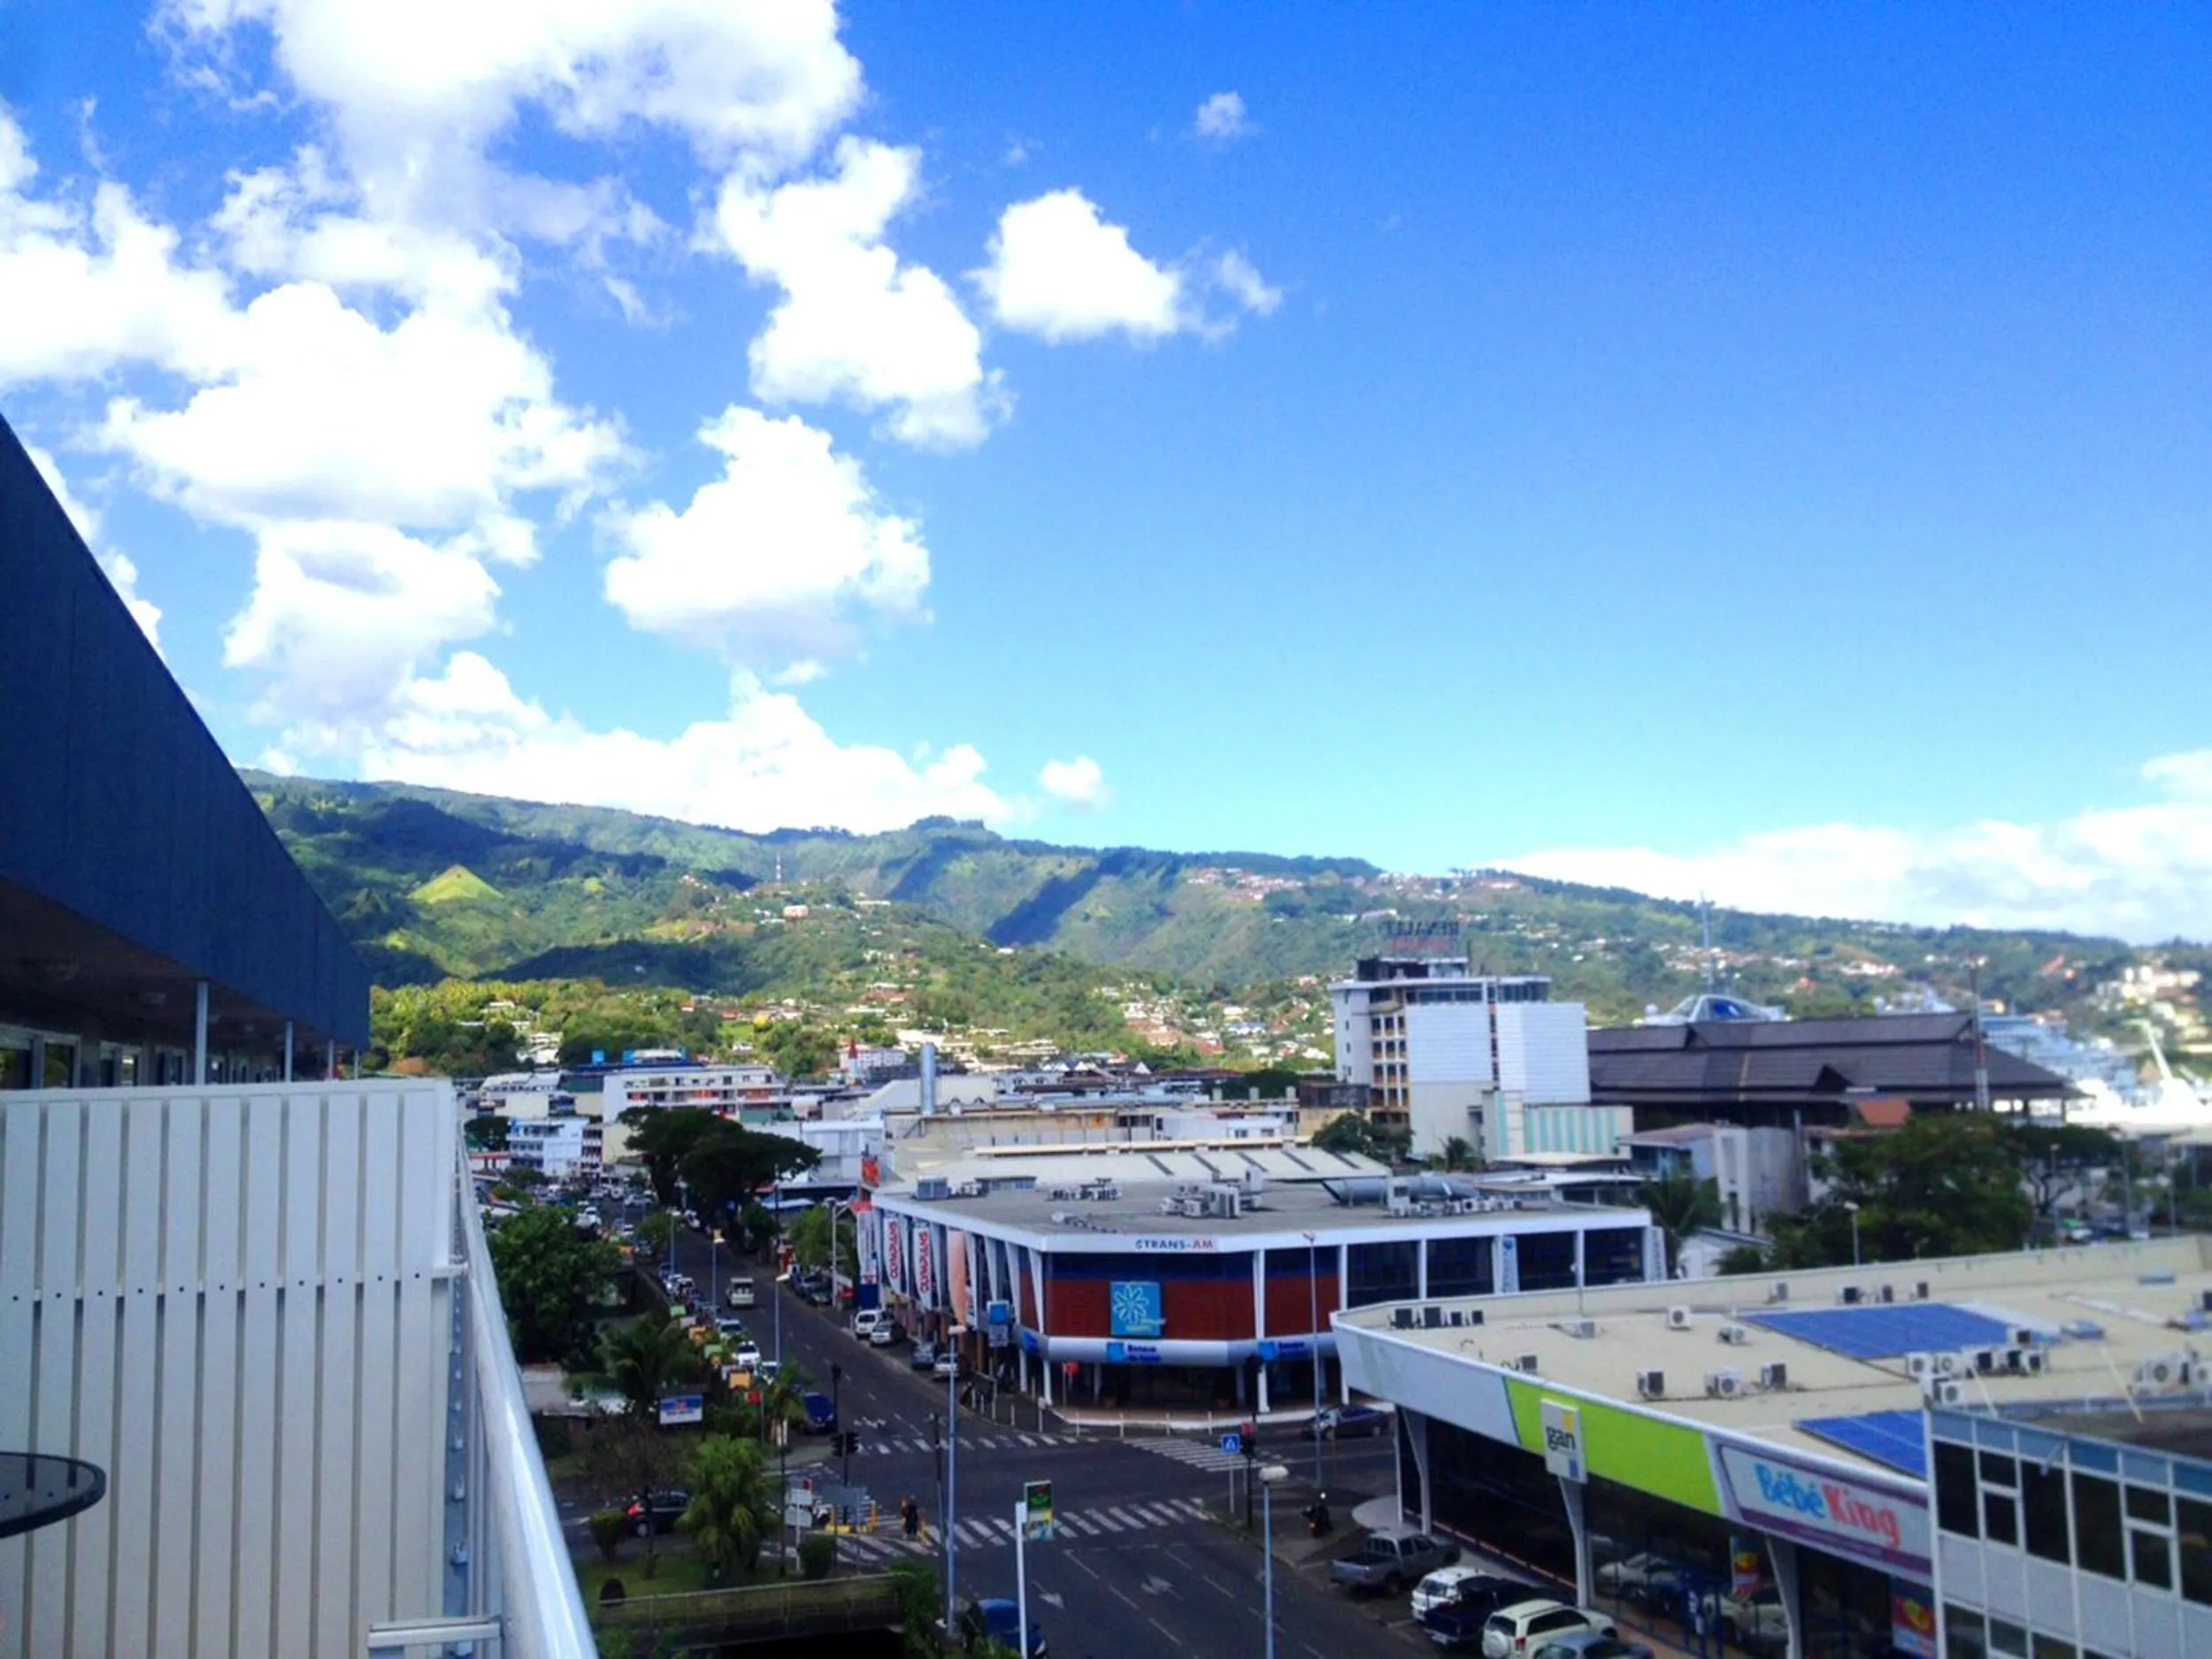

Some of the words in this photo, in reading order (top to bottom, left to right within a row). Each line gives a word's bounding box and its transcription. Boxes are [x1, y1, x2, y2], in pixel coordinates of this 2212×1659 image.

[1546, 1426, 1576, 1451] gan
[1755, 1463, 1825, 1519] Bébé
[1823, 1484, 1901, 1553] King
